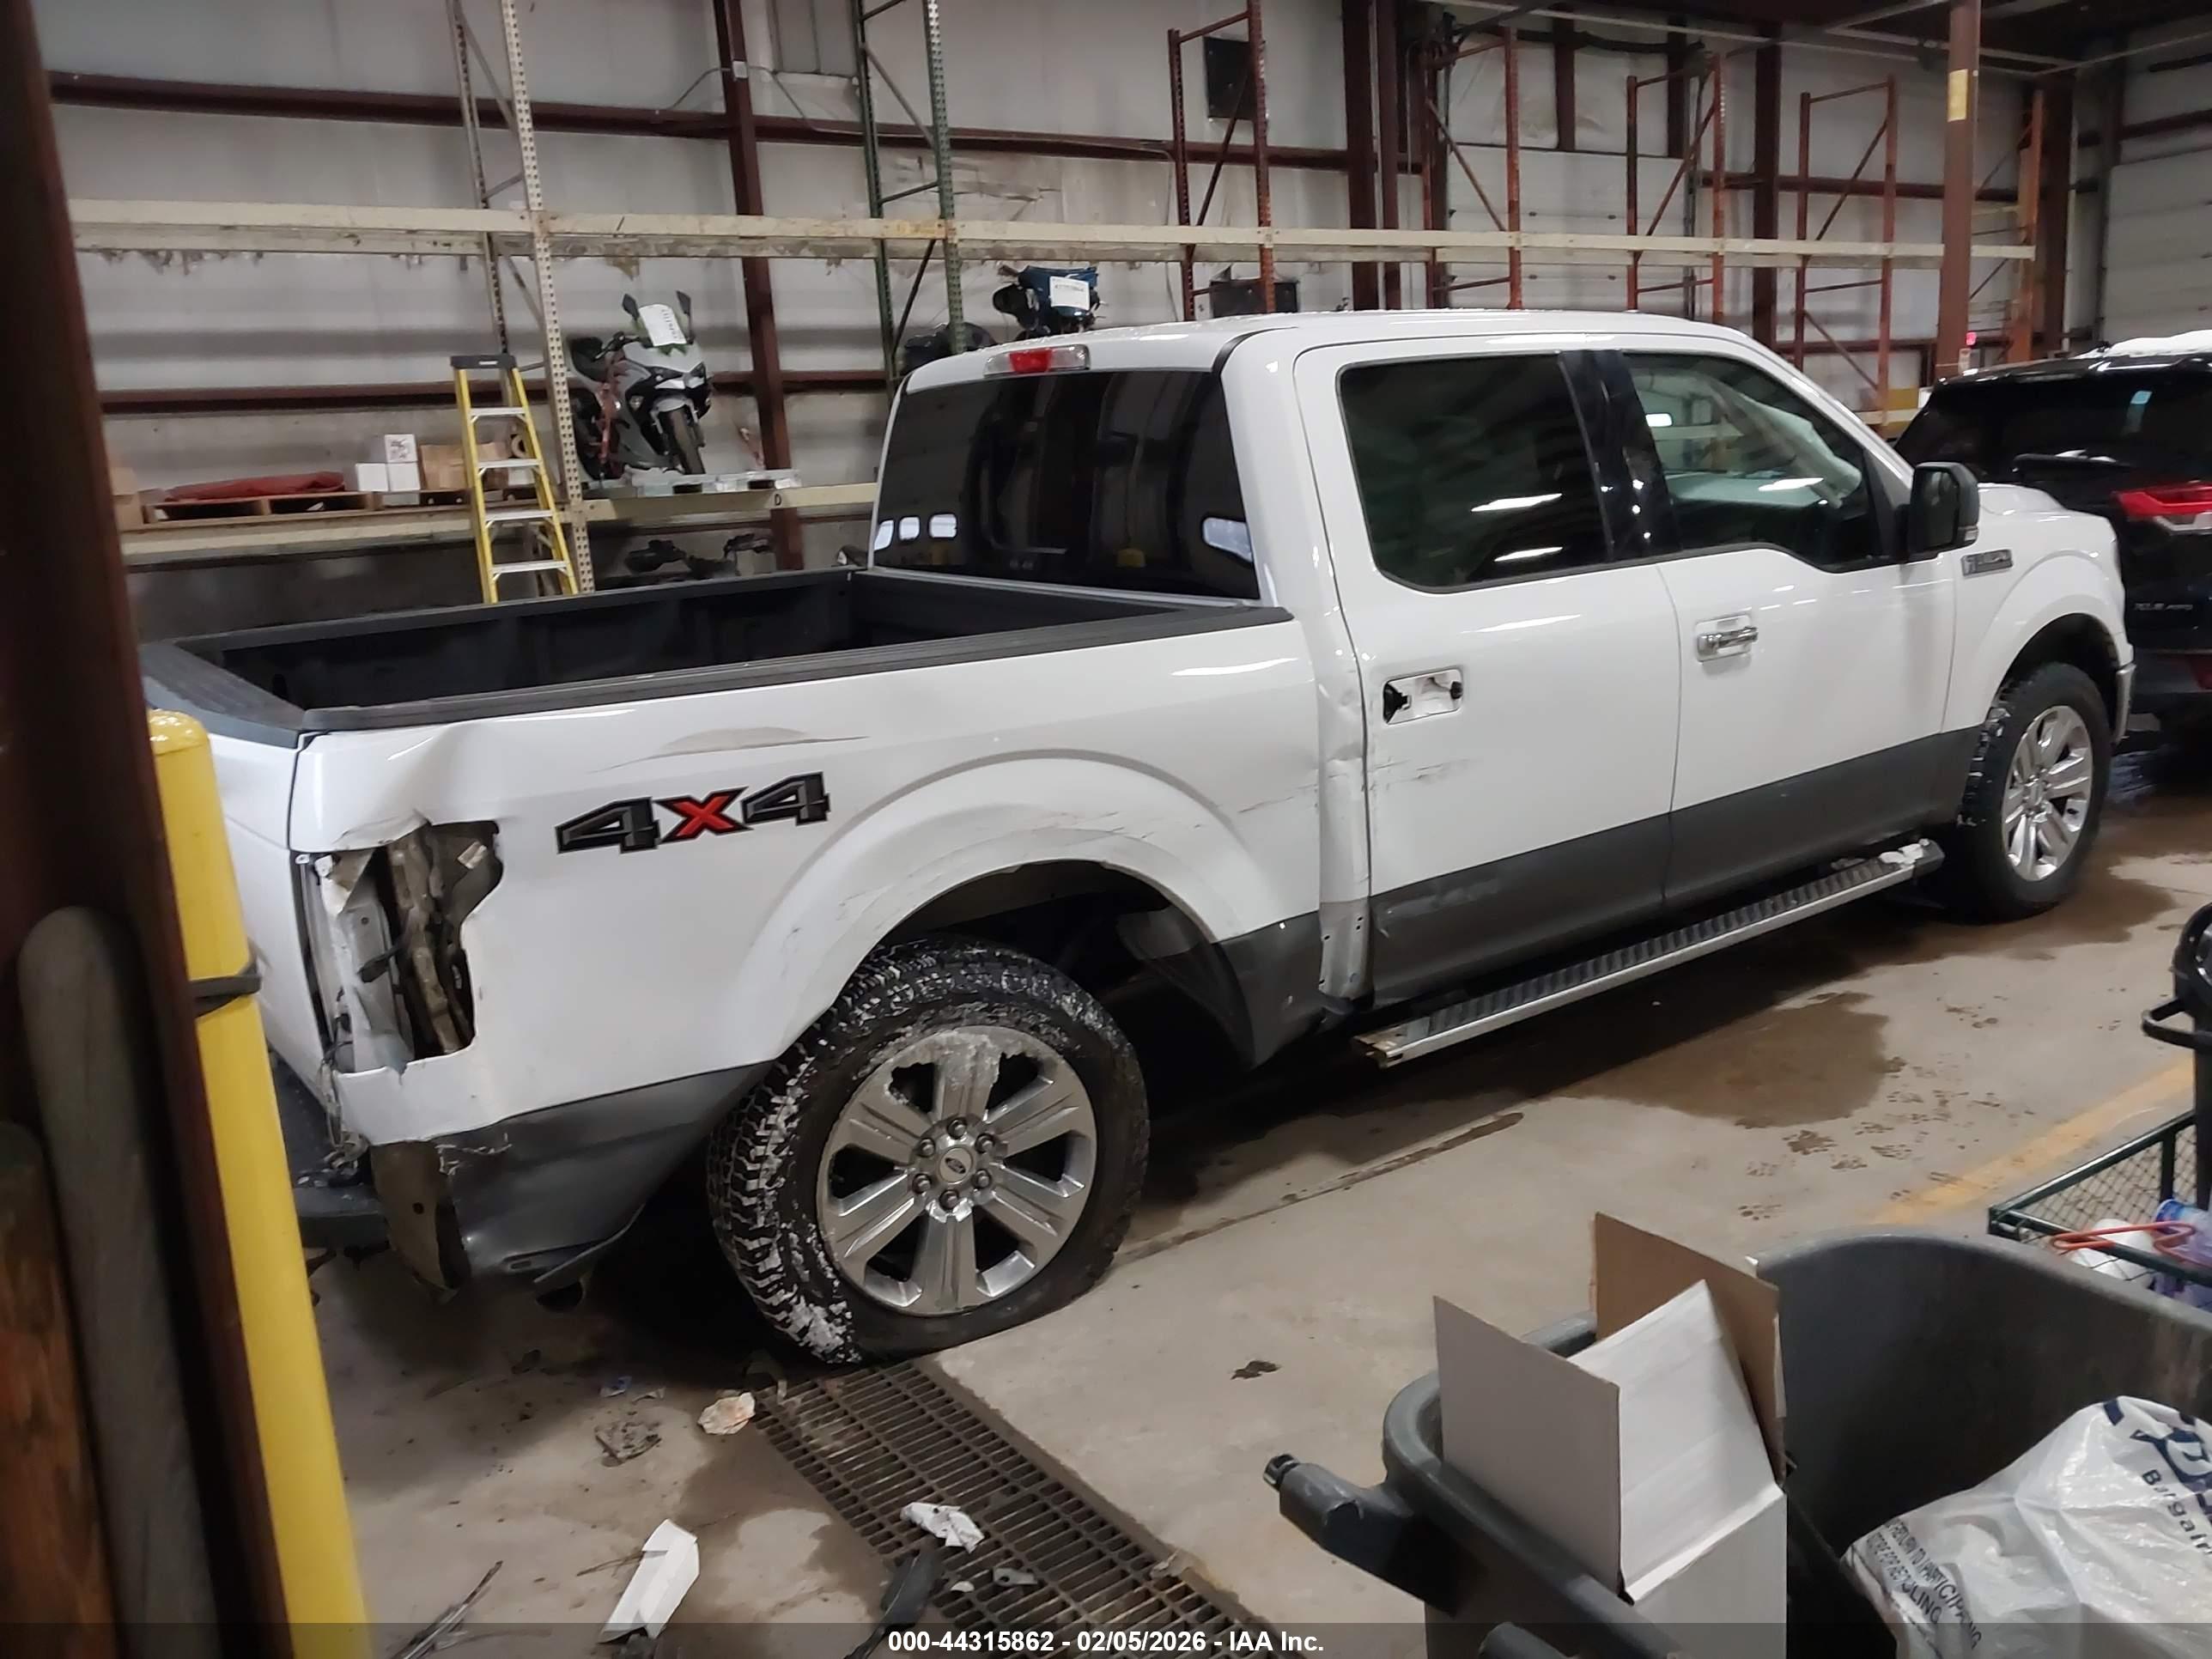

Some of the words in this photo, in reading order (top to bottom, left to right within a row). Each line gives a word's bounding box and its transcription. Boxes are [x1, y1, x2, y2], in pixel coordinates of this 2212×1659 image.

[774, 493, 782, 506] D
[1888, 1565, 1942, 1625] RECCLING
[1923, 1561, 1982, 1650] PARTICIPANG
